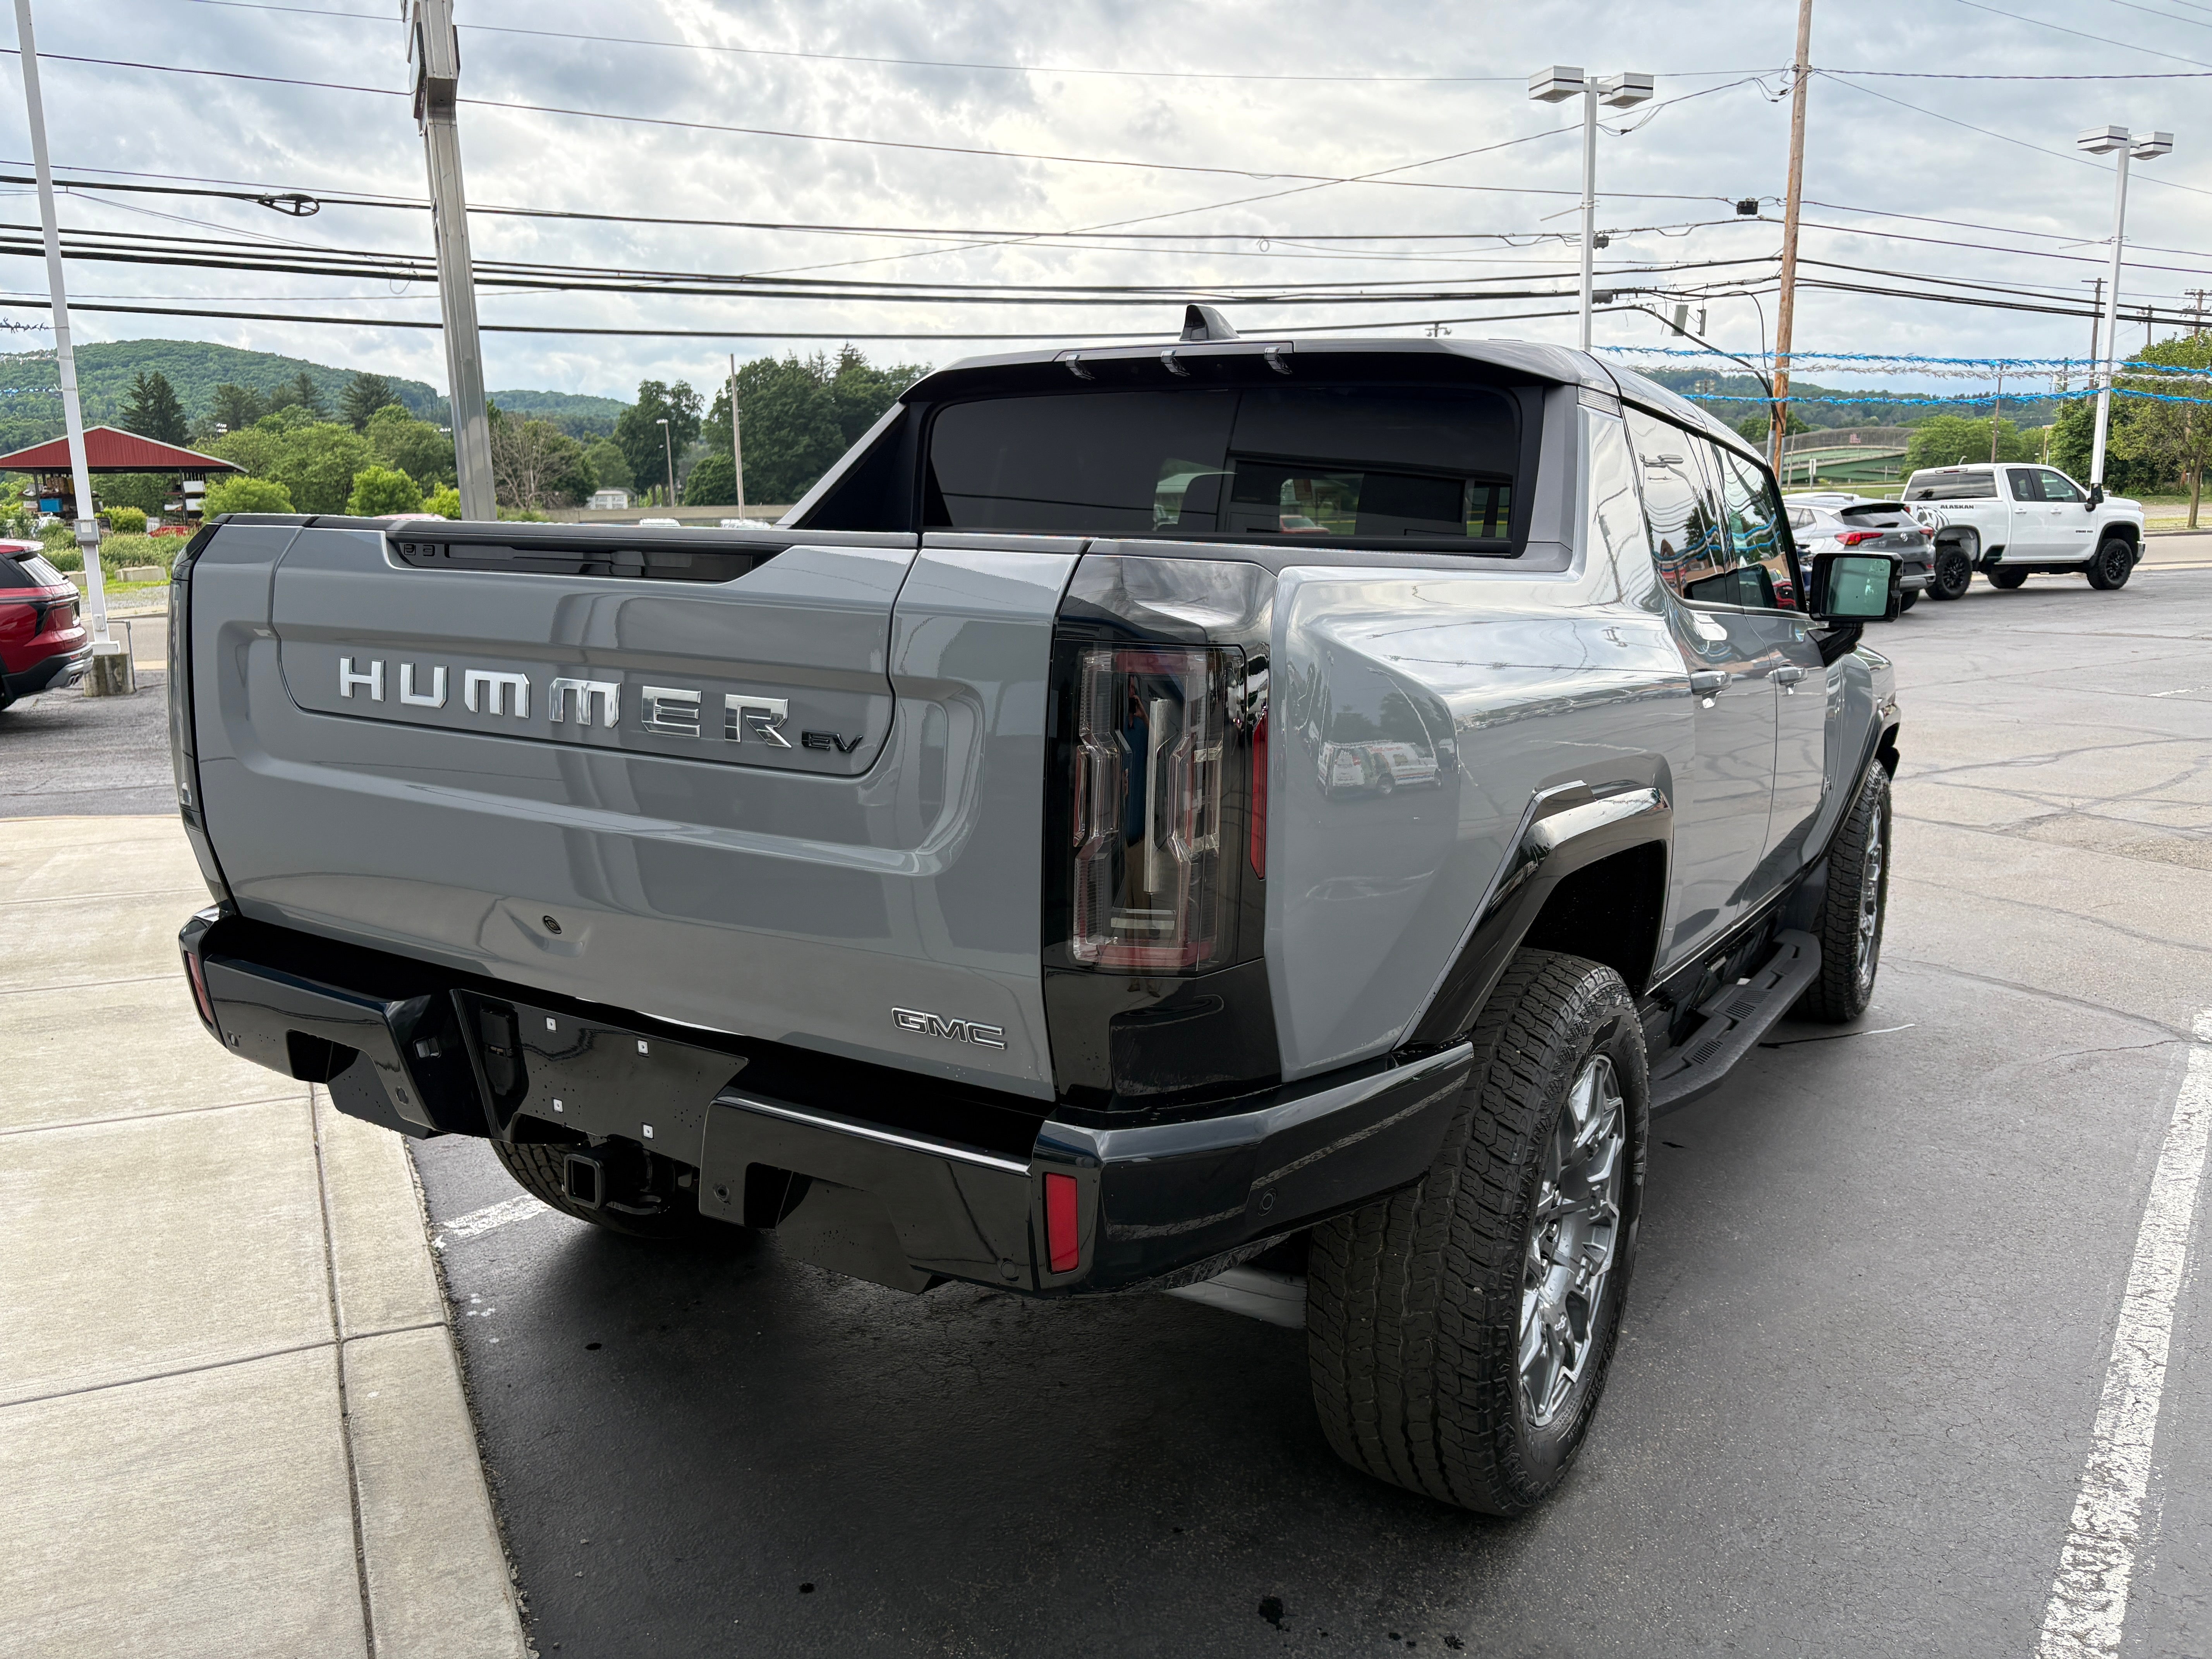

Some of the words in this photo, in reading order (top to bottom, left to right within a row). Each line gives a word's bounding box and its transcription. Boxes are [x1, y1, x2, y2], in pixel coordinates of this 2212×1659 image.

[340, 656, 792, 749] HUMMER
[801, 729, 863, 753] EV
[891, 1006, 1007, 1050] GMC
